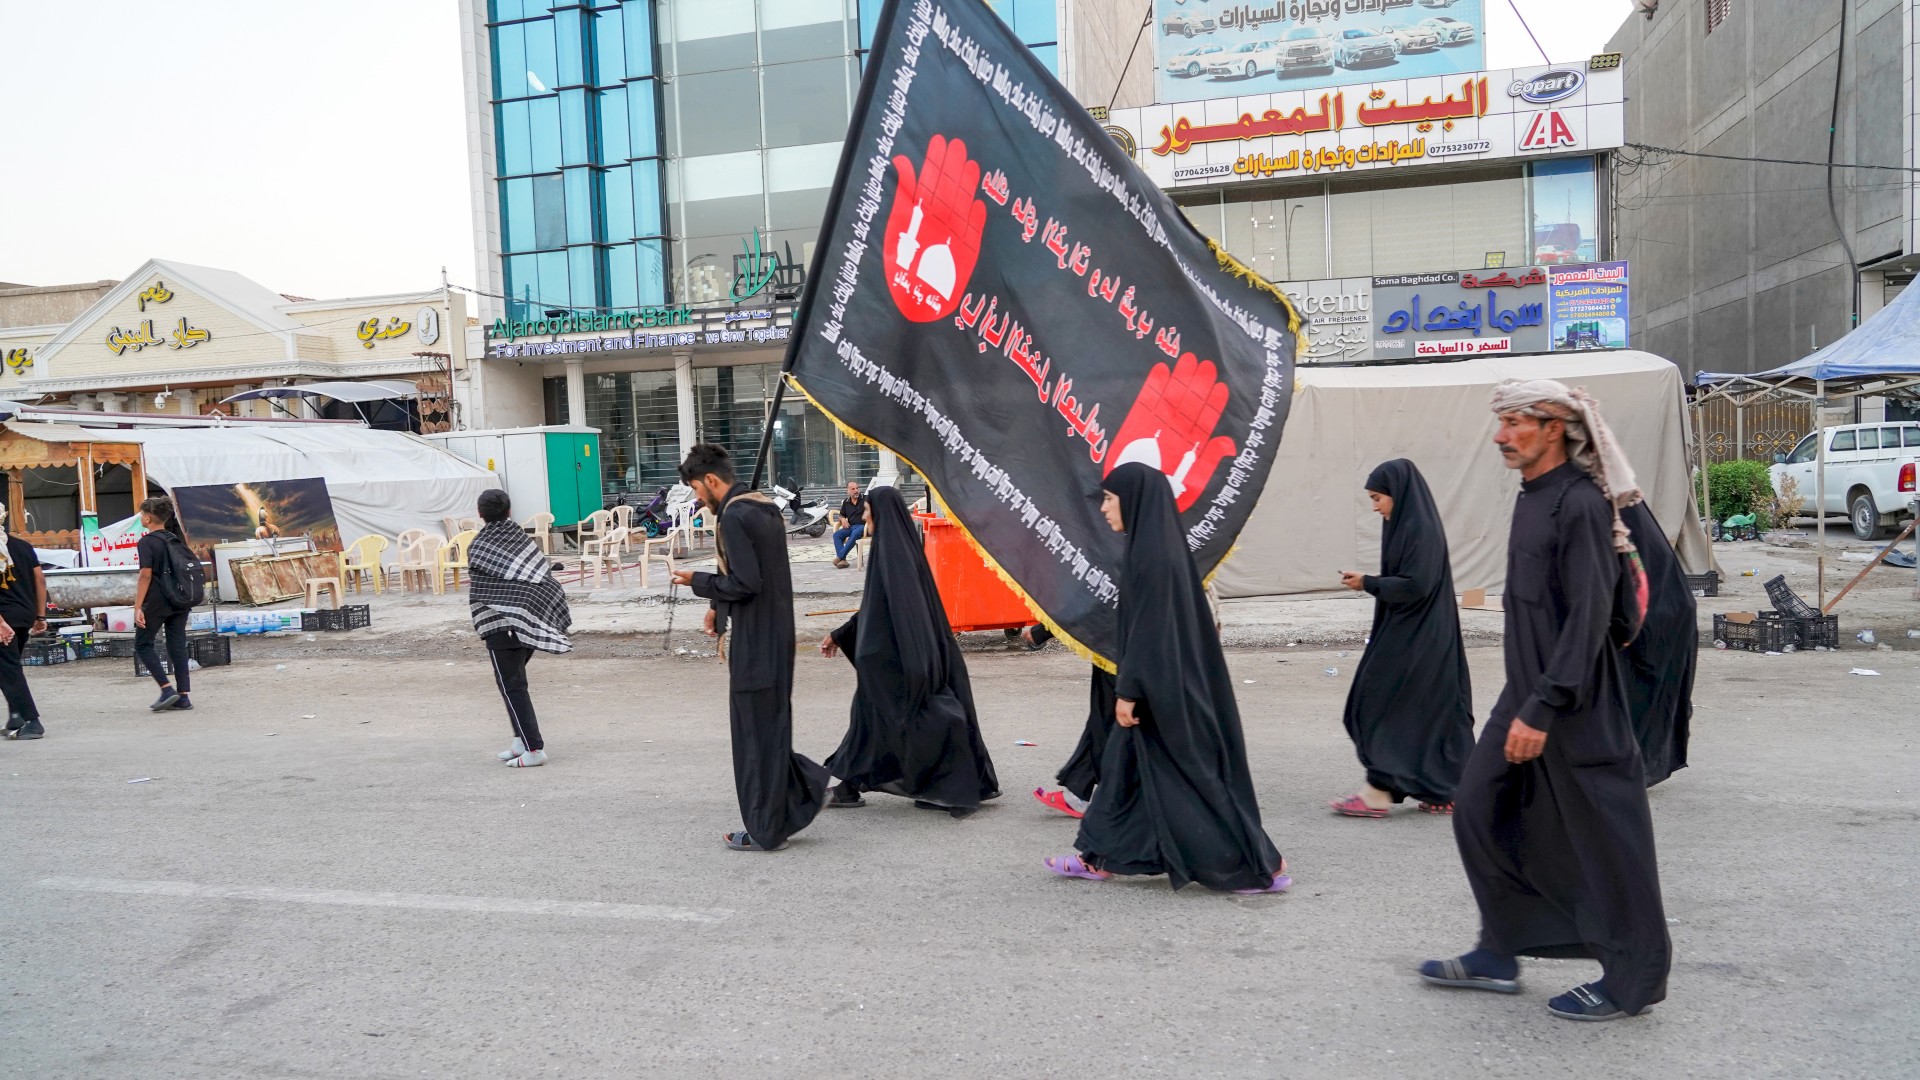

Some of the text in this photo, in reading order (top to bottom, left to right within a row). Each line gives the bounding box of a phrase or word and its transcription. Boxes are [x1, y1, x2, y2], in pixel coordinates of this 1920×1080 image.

[1219, 1, 1286, 29] السيارات
[1508, 72, 1575, 97] Copart
[1152, 76, 1489, 156] البيت المعمور
[1233, 137, 1425, 177] للمزادات وتجارة السيارات
[1430, 141, 1490, 154] 07753230772
[1174, 164, 1230, 178] 07704259428
[1375, 273, 1456, 286] Sama Baghdad Co.
[1460, 268, 1547, 289] شركة
[1553, 267, 1624, 285] البيت المعمور
[138, 281, 174, 312] مطعم
[1591, 286, 1623, 295] للمزادات
[491, 304, 694, 343] Aljanoob Islamic Bank
[1329, 315, 1367, 323] FRESHENER
[1382, 290, 1543, 337] سما بغداد
[106, 317, 211, 355] دار اليمن
[357, 317, 411, 349] مندي
[705, 325, 789, 344] we Grow Together
[496, 343, 520, 358] For
[604, 335, 632, 351] and
[1418, 342, 1464, 355] السياحة
[1477, 339, 1508, 352] للسفر
